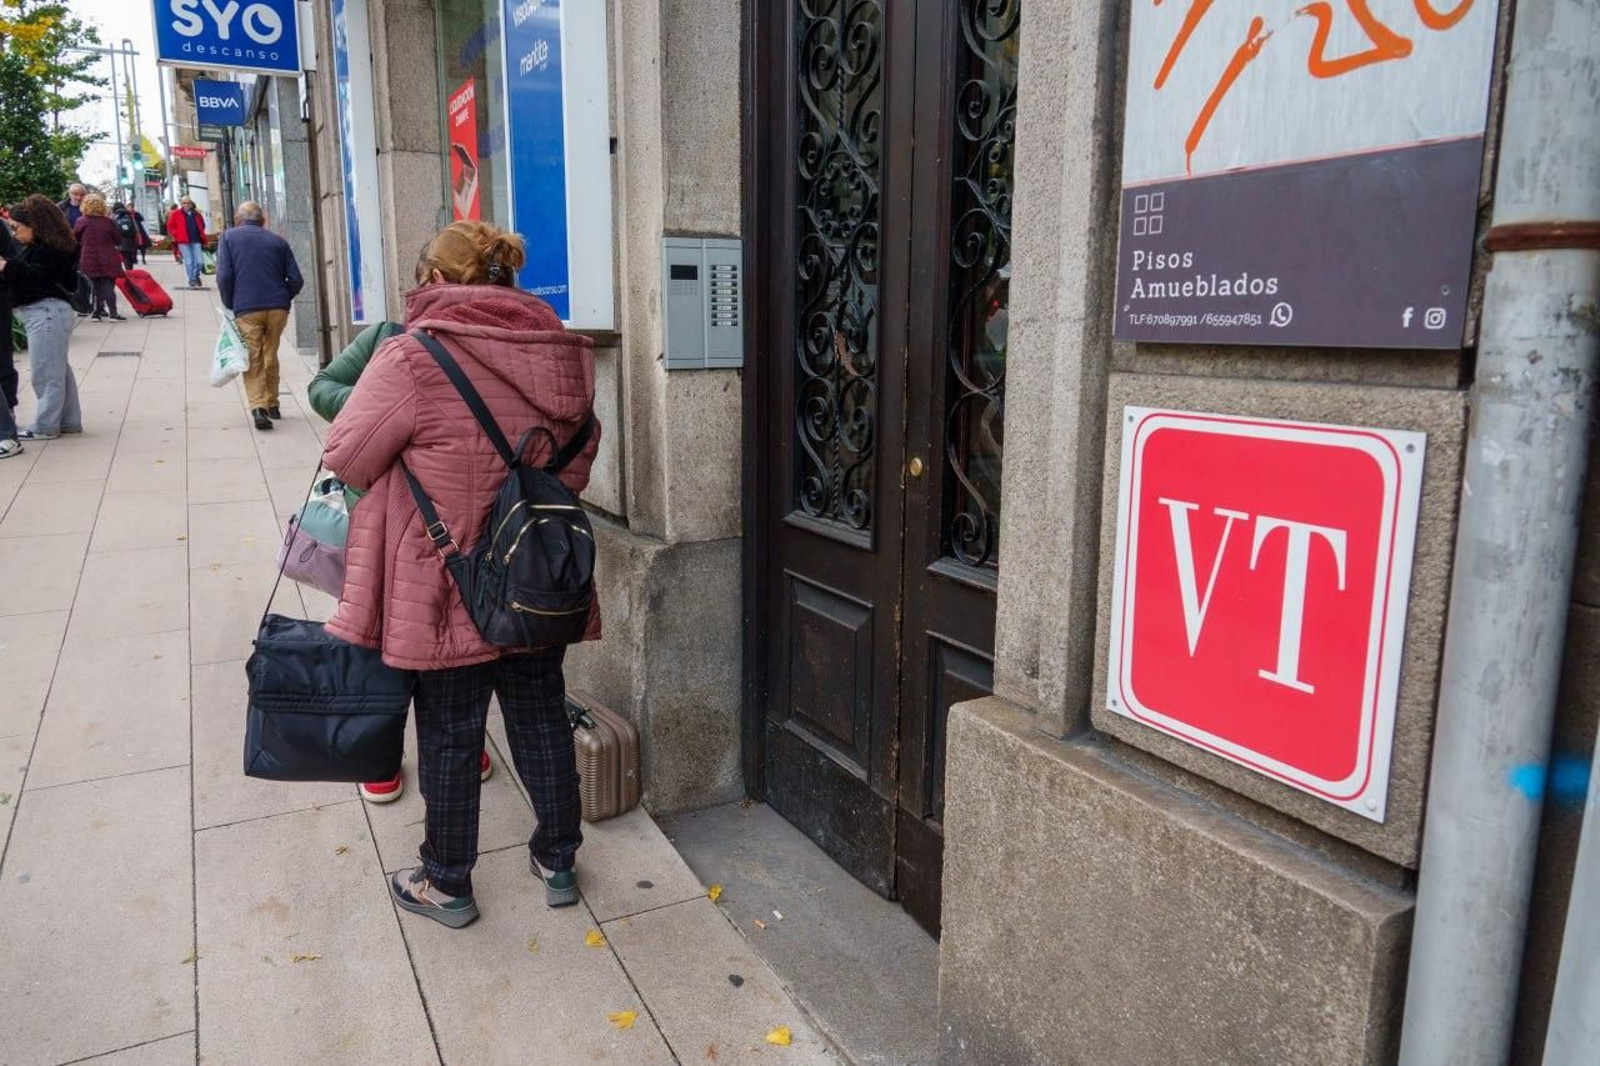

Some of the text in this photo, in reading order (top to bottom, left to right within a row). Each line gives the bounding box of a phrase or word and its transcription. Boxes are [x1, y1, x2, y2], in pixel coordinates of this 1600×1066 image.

[170, 0, 282, 45] SYO
[181, 41, 279, 61] descanso
[199, 96, 239, 108] BBVA
[1131, 250, 1194, 271] Pisos
[1130, 272, 1279, 298] Amueblados
[1158, 496, 1348, 695] VT
